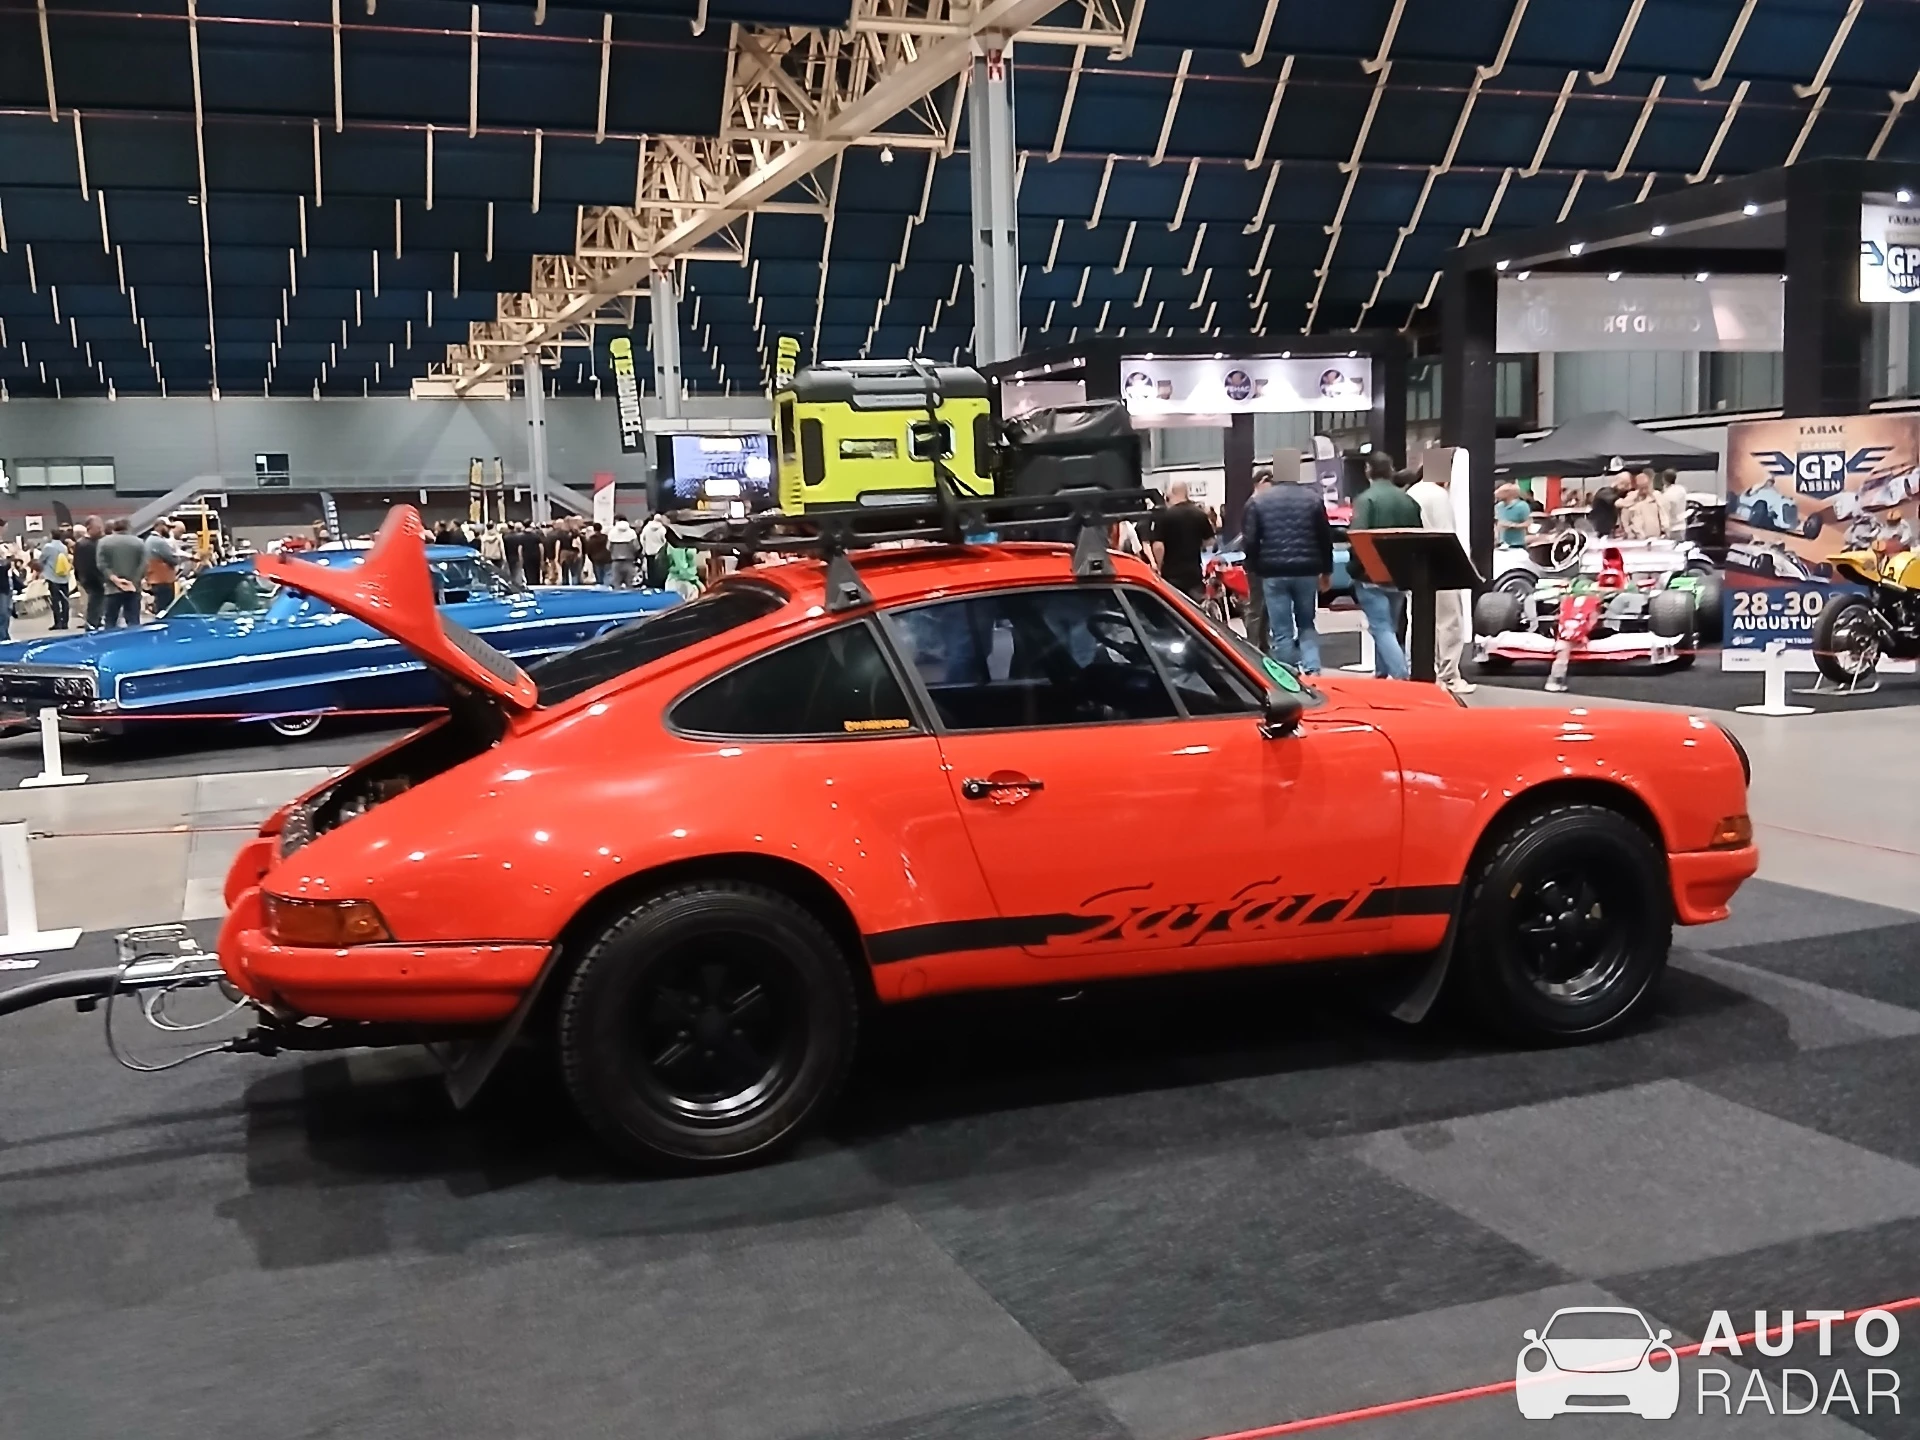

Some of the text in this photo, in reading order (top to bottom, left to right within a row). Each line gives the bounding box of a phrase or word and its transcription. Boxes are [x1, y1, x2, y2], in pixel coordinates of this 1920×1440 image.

[1888, 247, 1920, 275] GP
[1799, 454, 1843, 480] GP
[1732, 591, 1824, 616] 28-30
[1047, 876, 1388, 948] Safari
